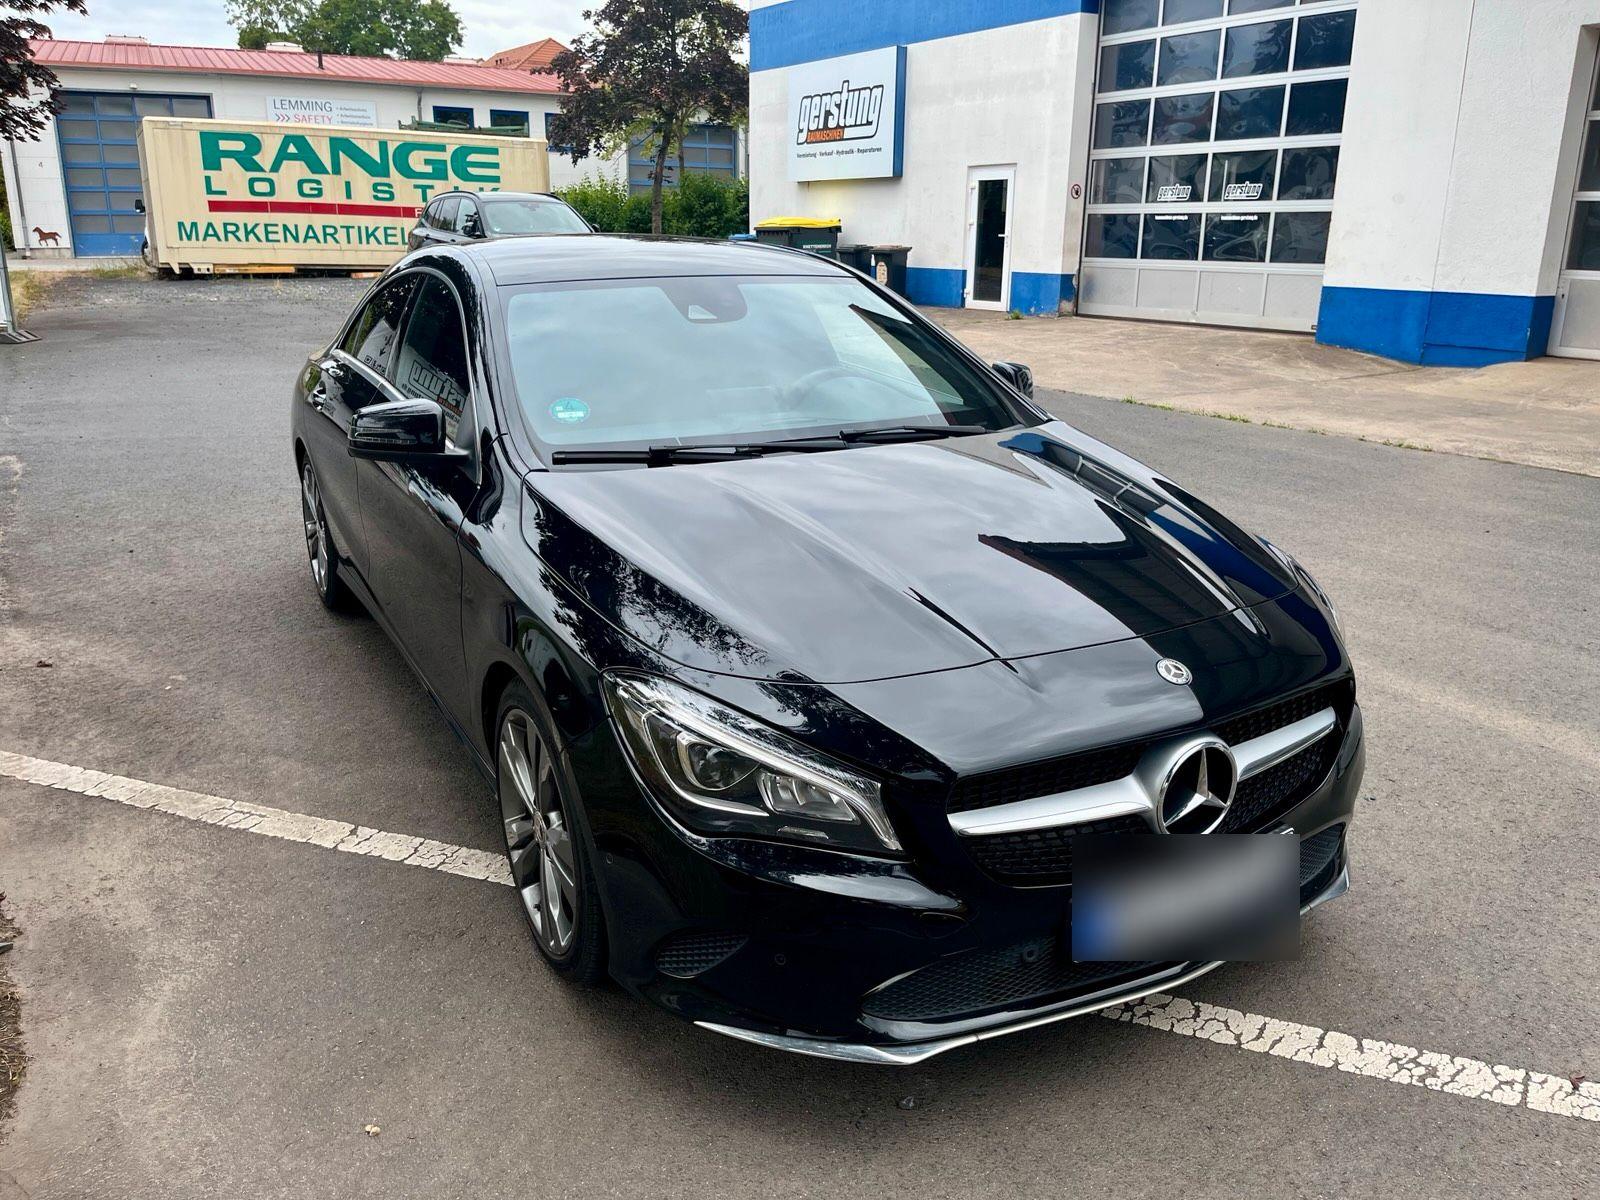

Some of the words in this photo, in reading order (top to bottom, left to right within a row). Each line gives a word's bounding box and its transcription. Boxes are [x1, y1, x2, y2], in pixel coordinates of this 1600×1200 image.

[273, 98, 333, 113] LEMMING
[797, 80, 884, 145] gerstung
[294, 113, 333, 125] SAFETY
[199, 131, 501, 184] RANGE
[204, 175, 500, 203] LOGIST
[1157, 183, 1192, 201] gerstung
[1224, 181, 1263, 200] gerstung
[177, 221, 409, 246] MARKENARTIKEL
